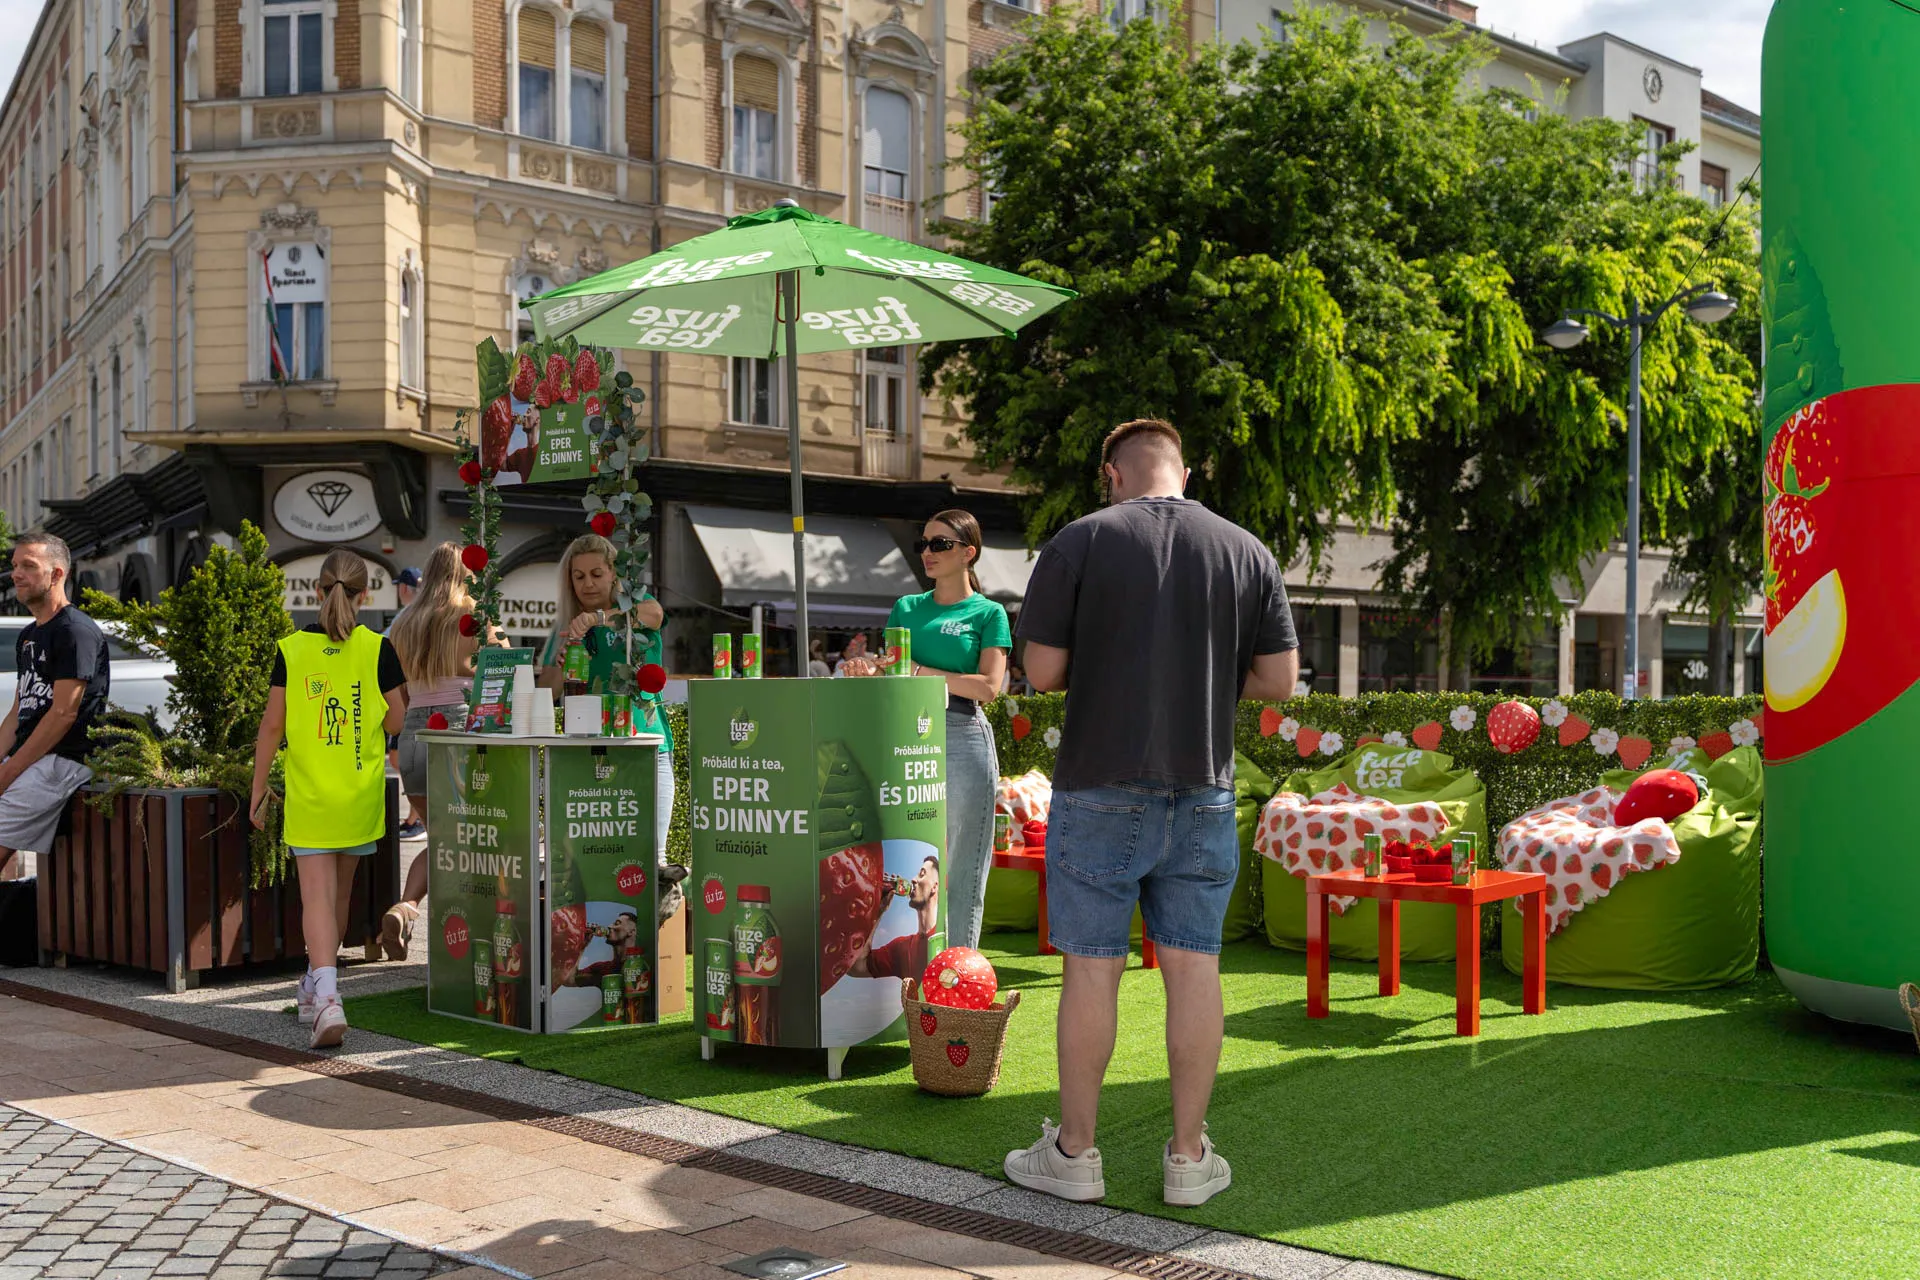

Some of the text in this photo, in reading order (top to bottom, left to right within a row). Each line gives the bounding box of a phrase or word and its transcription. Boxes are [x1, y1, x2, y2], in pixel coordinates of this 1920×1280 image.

[647, 251, 773, 275] fuze
[551, 437, 571, 450] EPER
[540, 450, 583, 465] ÉS DINNYE
[351, 681, 362, 771] STREETBALL
[731, 719, 754, 732] fuze
[731, 731, 748, 741] tea
[894, 745, 923, 756] Próbáld
[923, 744, 929, 754] ki
[702, 755, 785, 772] Próbáld ki a tea,
[1360, 750, 1423, 769] fuze
[472, 769, 490, 782] fuze
[904, 760, 938, 780] EPER
[1356, 765, 1404, 789] tea
[472, 780, 486, 790] tea
[569, 788, 601, 798] Próbáld
[603, 788, 611, 796] ki
[620, 789, 636, 797] tea,
[712, 776, 770, 802] EPER
[880, 781, 902, 806] ÉS
[448, 803, 477, 815] Próbáld
[478, 804, 486, 816] ki
[493, 808, 508, 820] tea,
[566, 796, 639, 818] EPER ÉS
[693, 798, 809, 834] ÉS DINNYE
[457, 822, 498, 847] EPER
[568, 820, 637, 839] DINNYE
[583, 843, 624, 855] ízfúzióját
[715, 839, 768, 857] ízfúzióját
[436, 842, 522, 879] ÉS DINNYE
[620, 873, 644, 888] ÚJ ÍZ
[705, 889, 724, 904] ÚJ ÍZ
[446, 928, 468, 945] ÚJ ÍZ
[734, 925, 763, 943] fuze
[735, 941, 755, 954] tea
[474, 974, 489, 986] tea
[706, 965, 731, 984] fuze
[707, 982, 725, 996] tea
